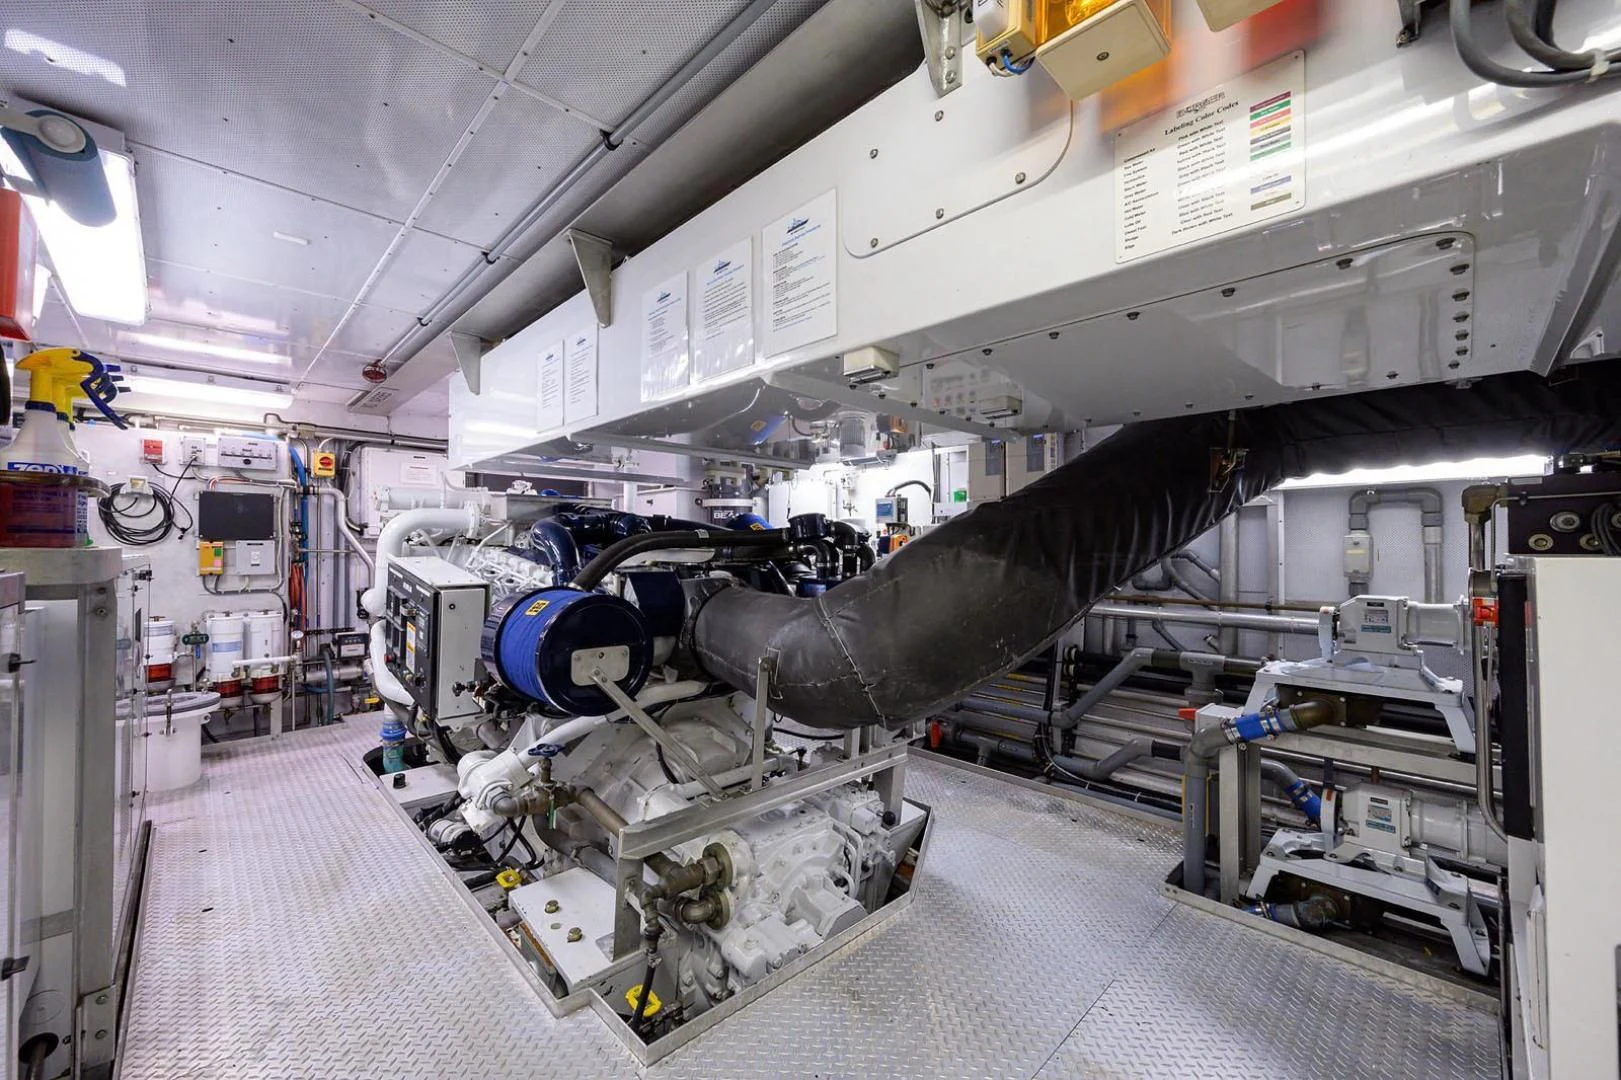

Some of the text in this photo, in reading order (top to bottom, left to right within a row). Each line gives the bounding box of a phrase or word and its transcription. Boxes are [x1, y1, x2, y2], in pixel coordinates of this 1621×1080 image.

[1165, 120, 1193, 134] Labeling
[1195, 110, 1214, 122] Color
[1217, 100, 1238, 113] Codes
